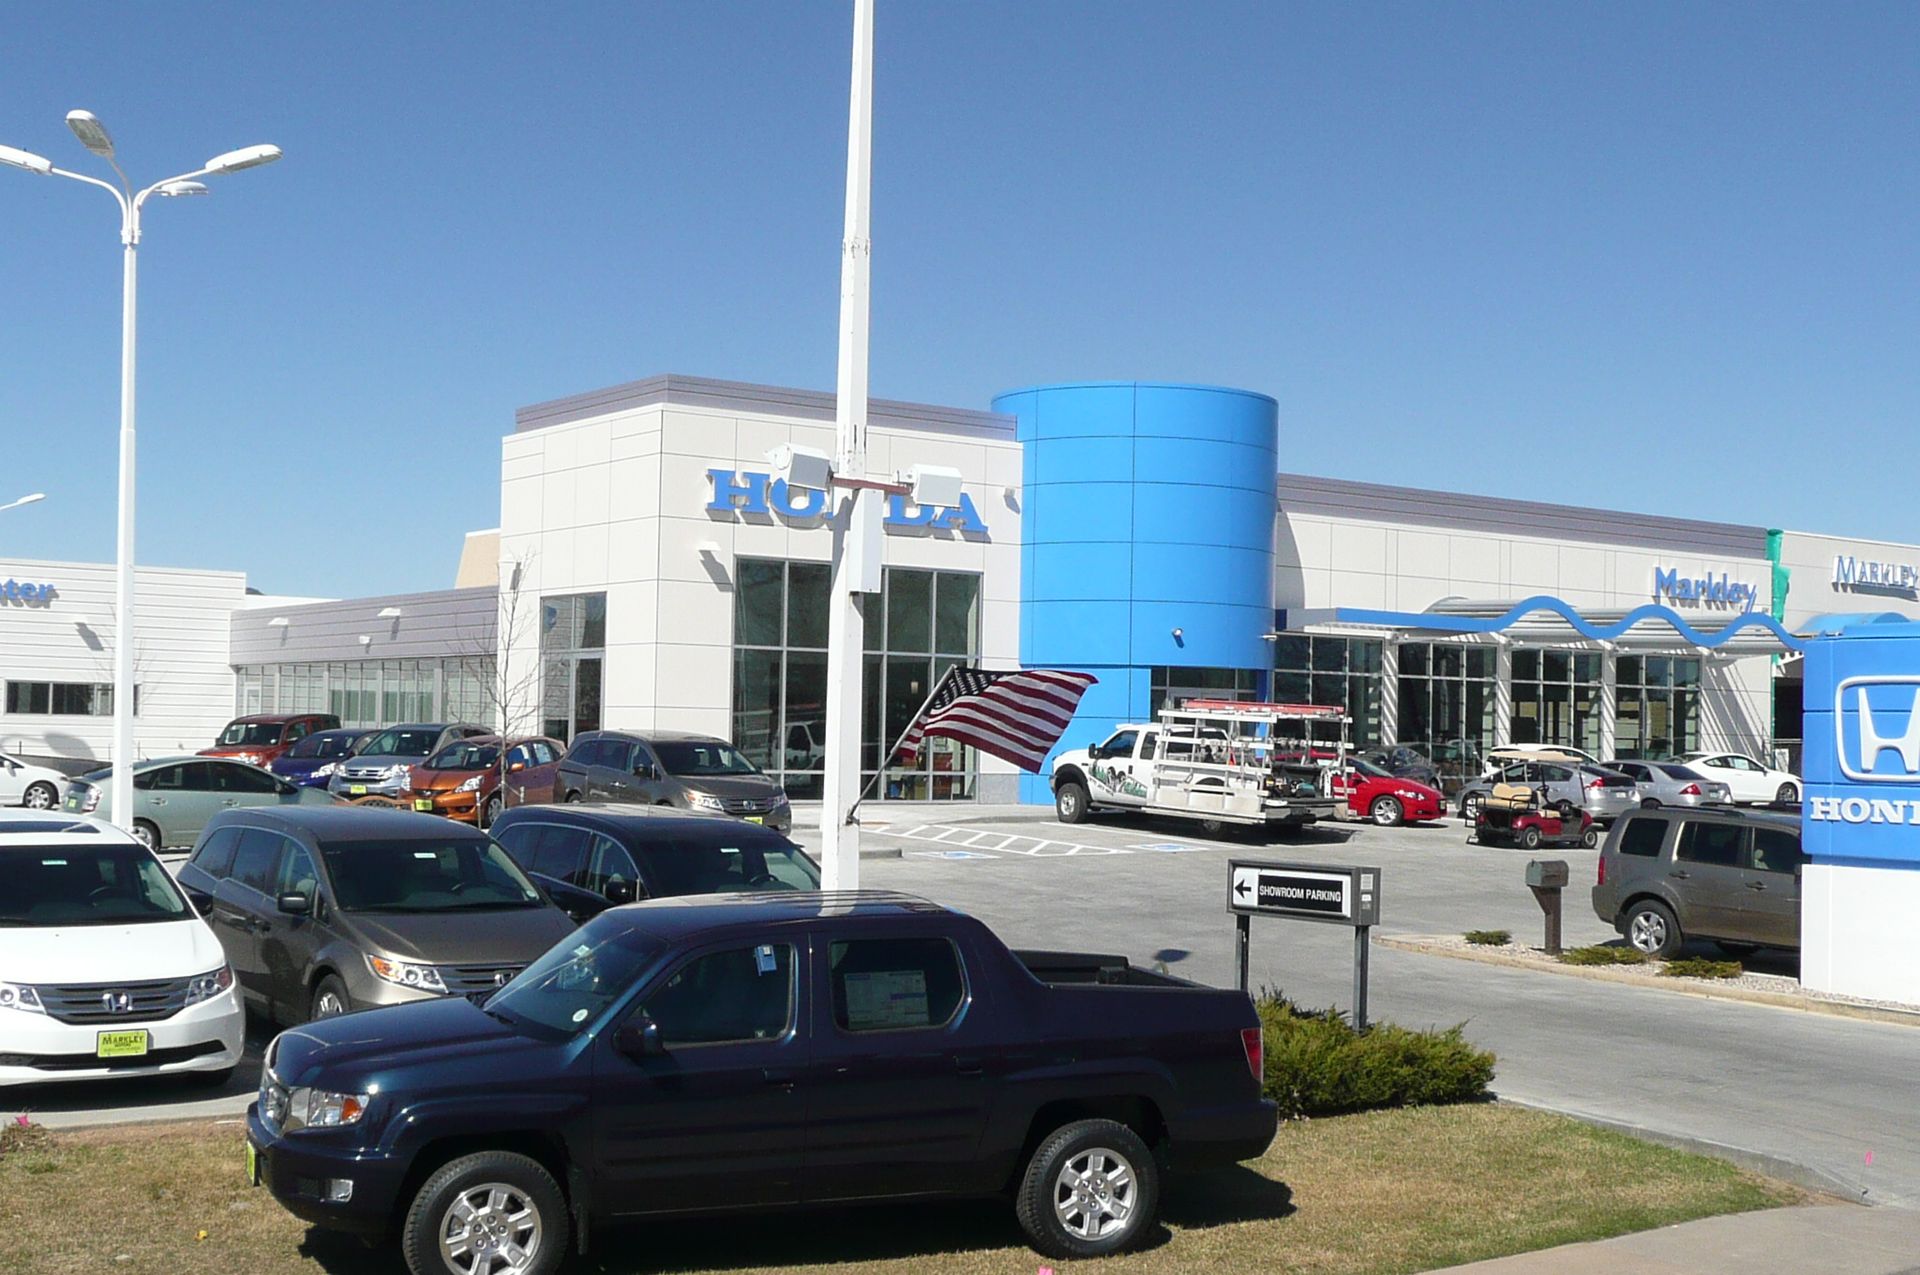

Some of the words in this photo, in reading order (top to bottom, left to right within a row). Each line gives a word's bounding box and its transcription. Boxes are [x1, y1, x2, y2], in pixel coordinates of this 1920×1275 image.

[0, 578, 54, 602] ter
[1655, 566, 1757, 613] Markley
[1259, 886, 1304, 900] SHOWROOM
[1305, 888, 1342, 903] PARKING
